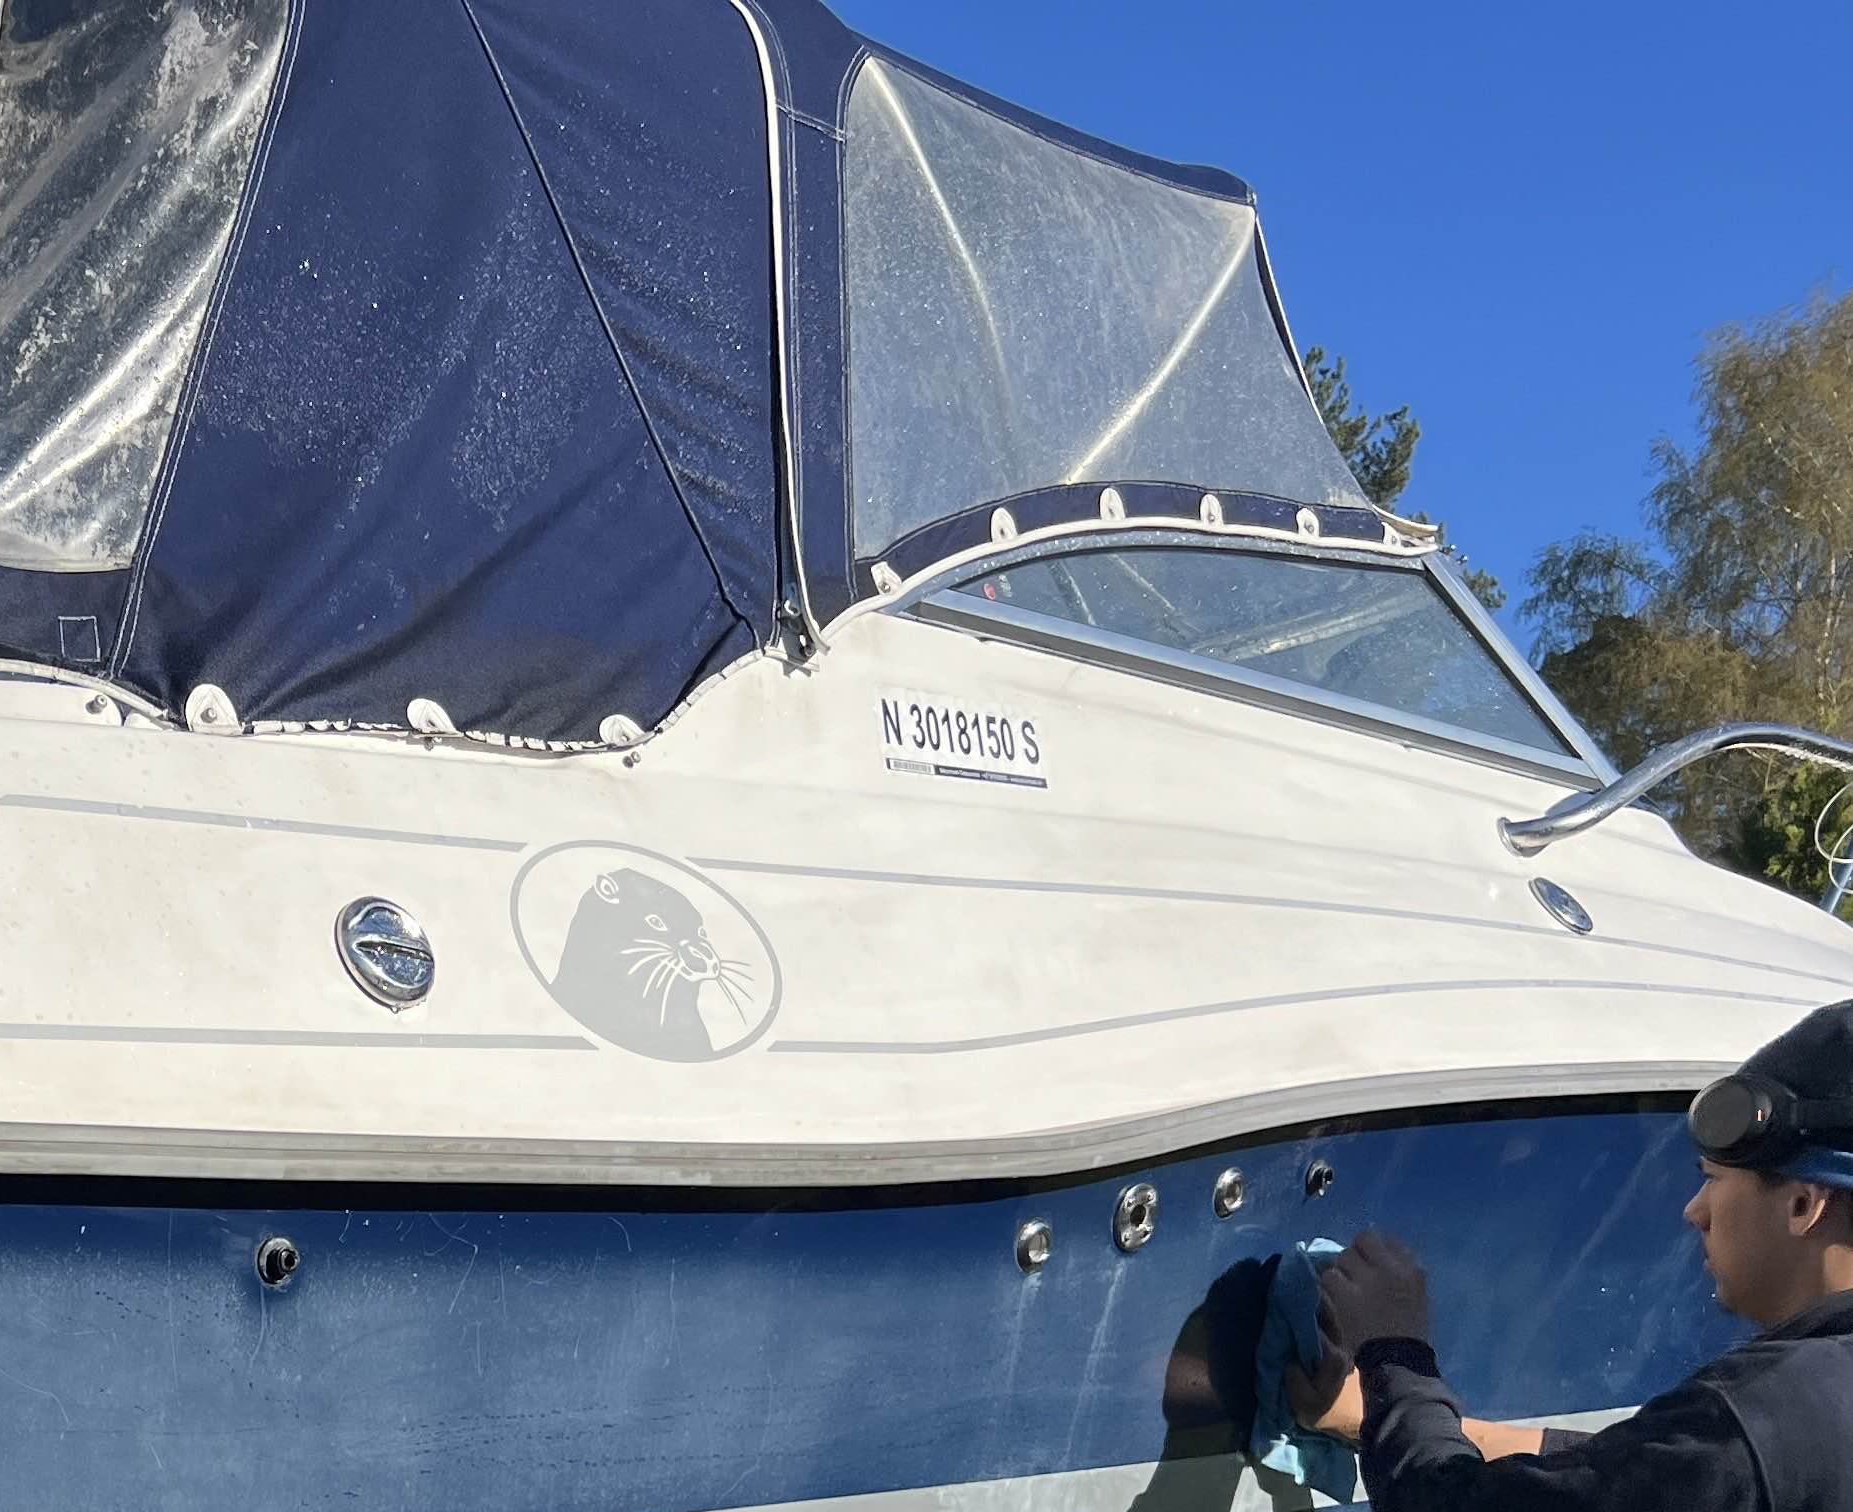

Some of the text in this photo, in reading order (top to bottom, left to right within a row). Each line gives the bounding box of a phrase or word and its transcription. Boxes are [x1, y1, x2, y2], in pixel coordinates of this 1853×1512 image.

[880, 698, 1040, 765] N 3018150 S
